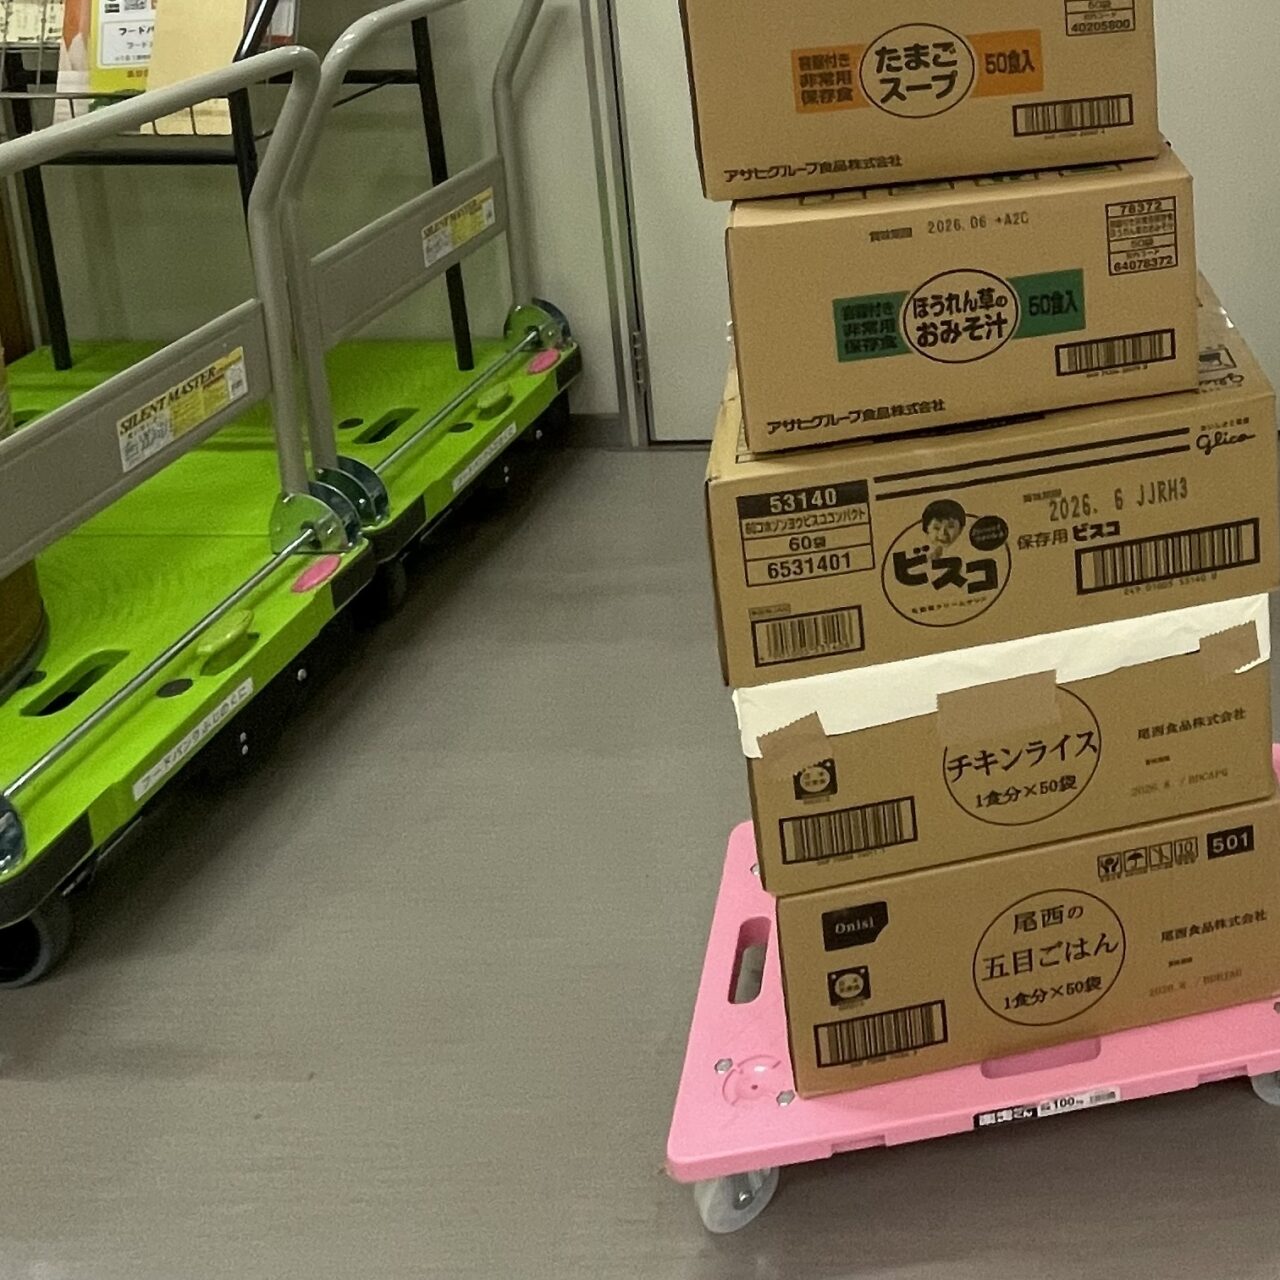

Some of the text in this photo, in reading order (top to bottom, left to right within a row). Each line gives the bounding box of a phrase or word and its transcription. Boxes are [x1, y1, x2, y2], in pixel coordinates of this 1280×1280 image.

[875, 42, 958, 74] たまご
[984, 50, 1036, 75] 50食入
[800, 70, 853, 88] 非常用
[879, 70, 959, 105] スープ
[723, 154, 903, 184] アサヒグループ食品株式会社
[912, 287, 1008, 320] ほうれん草の
[1028, 288, 1078, 317] 50食入
[915, 311, 1008, 347] おみそ汁
[120, 366, 218, 436] SILENT MASTER
[767, 399, 946, 435] アサヒグループ食品株式会社
[769, 487, 838, 513] 53140
[1049, 493, 1099, 522] 2026.
[1114, 488, 1124, 511] 6
[1016, 520, 1121, 551] 保存用 ビスコ
[767, 551, 851, 580] 6531401
[892, 544, 999, 595] ビスコ
[947, 730, 1099, 783] チキンライス
[975, 774, 1079, 810] 1食分×50袋
[1212, 832, 1249, 854] 501
[1012, 902, 1084, 935] 尾西の
[981, 930, 1120, 982] 五目ごはん
[1003, 975, 1103, 1011] 1食分×50袋
